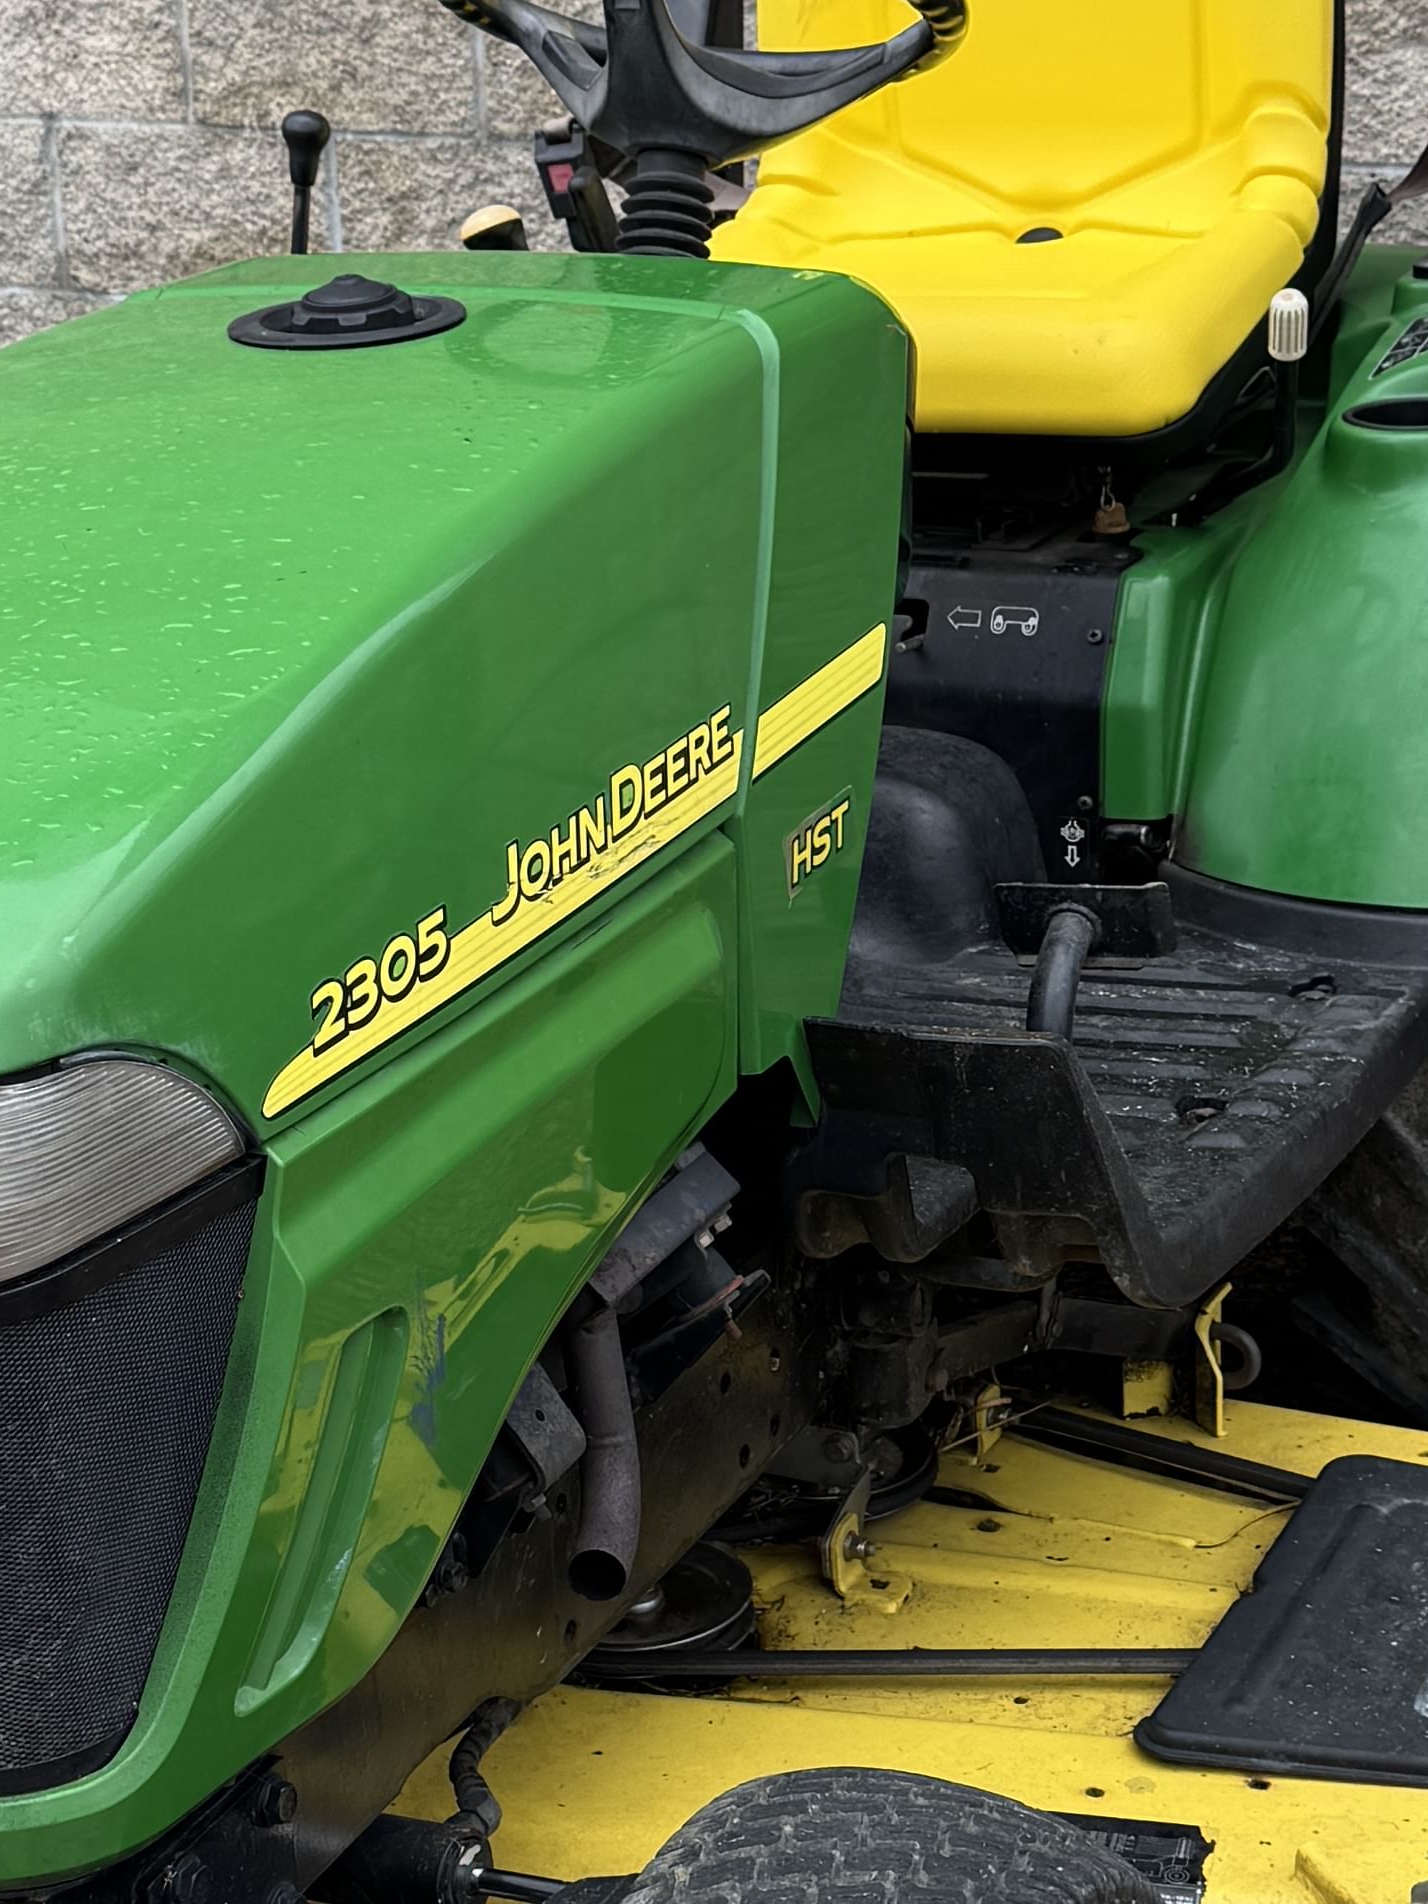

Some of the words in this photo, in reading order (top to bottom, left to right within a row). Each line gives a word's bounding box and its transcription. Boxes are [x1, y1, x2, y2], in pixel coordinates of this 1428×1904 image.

[310, 903, 451, 1057] 2305
[490, 790, 610, 927] JOHN
[608, 701, 733, 844] DEERE
[791, 796, 850, 888] HST
